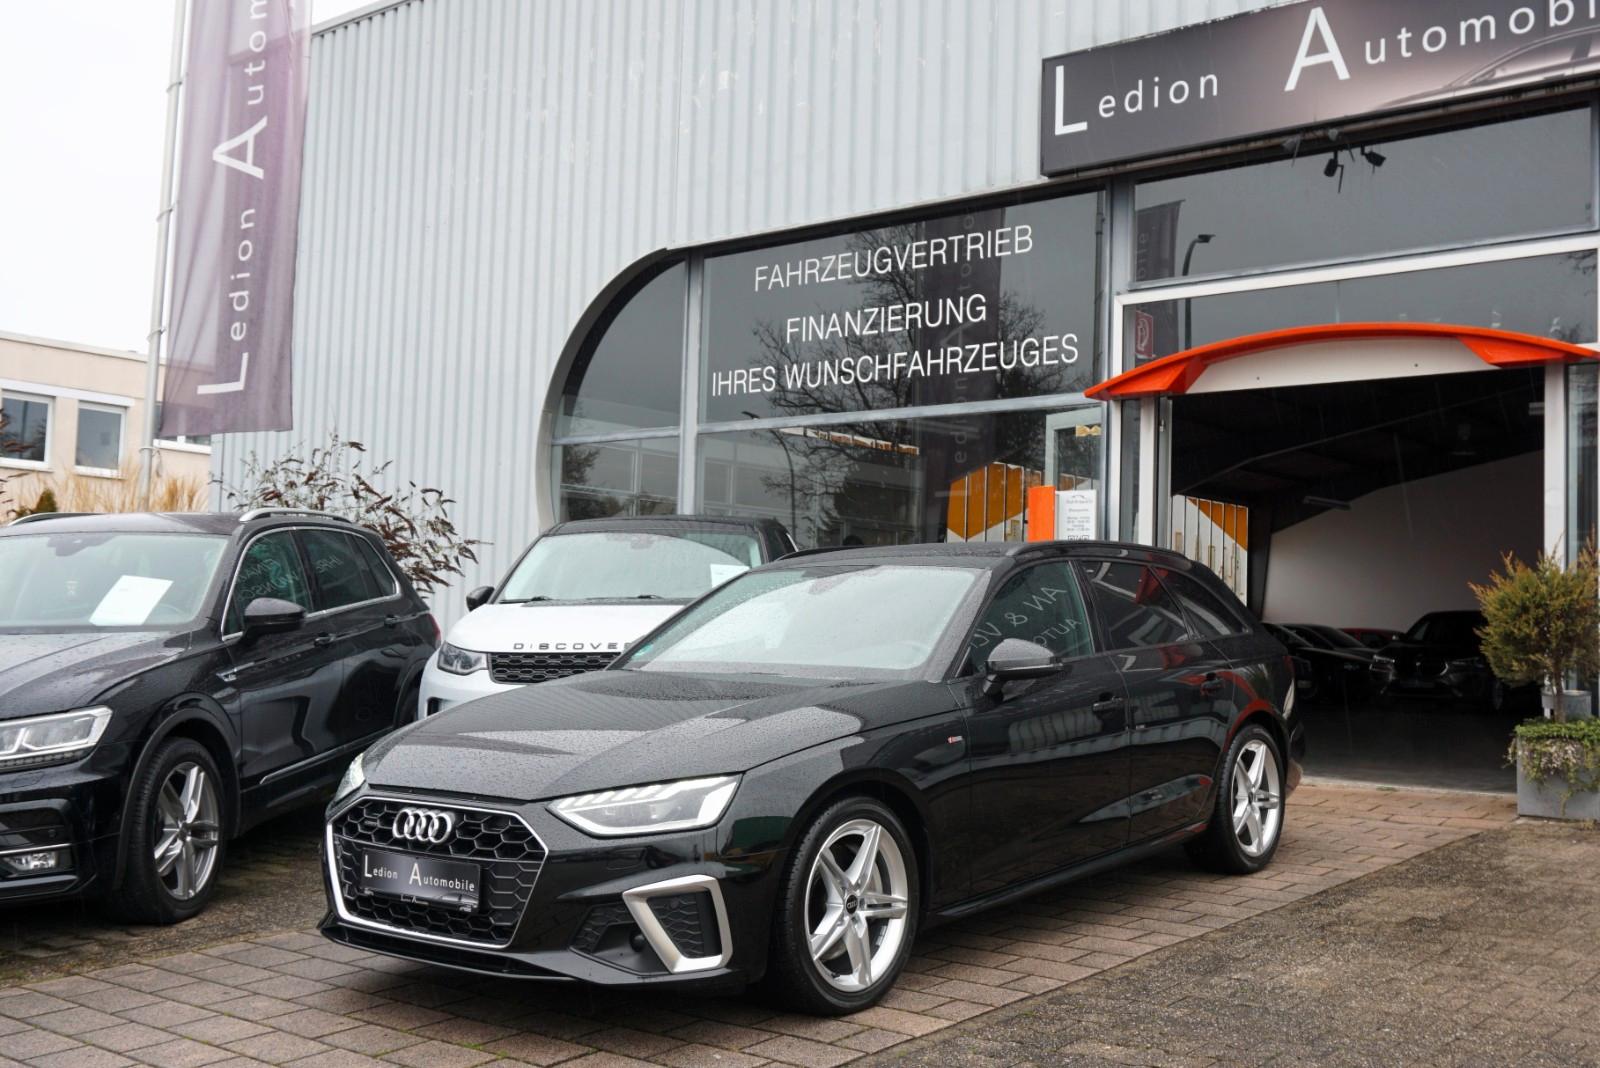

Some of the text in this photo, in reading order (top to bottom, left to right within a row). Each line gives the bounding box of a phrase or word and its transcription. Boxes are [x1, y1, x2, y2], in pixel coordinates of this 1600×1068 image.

[1054, 65, 1219, 136] Ledion
[754, 224, 1033, 292] FAHRZEUGVERTRIEB
[197, 208, 256, 394] Ledion
[786, 293, 987, 344] FINANZIERUNG
[712, 333, 1079, 397] IHRES WUNSCHFAHRZEUGES
[364, 854, 475, 892] Ledion Automobile
